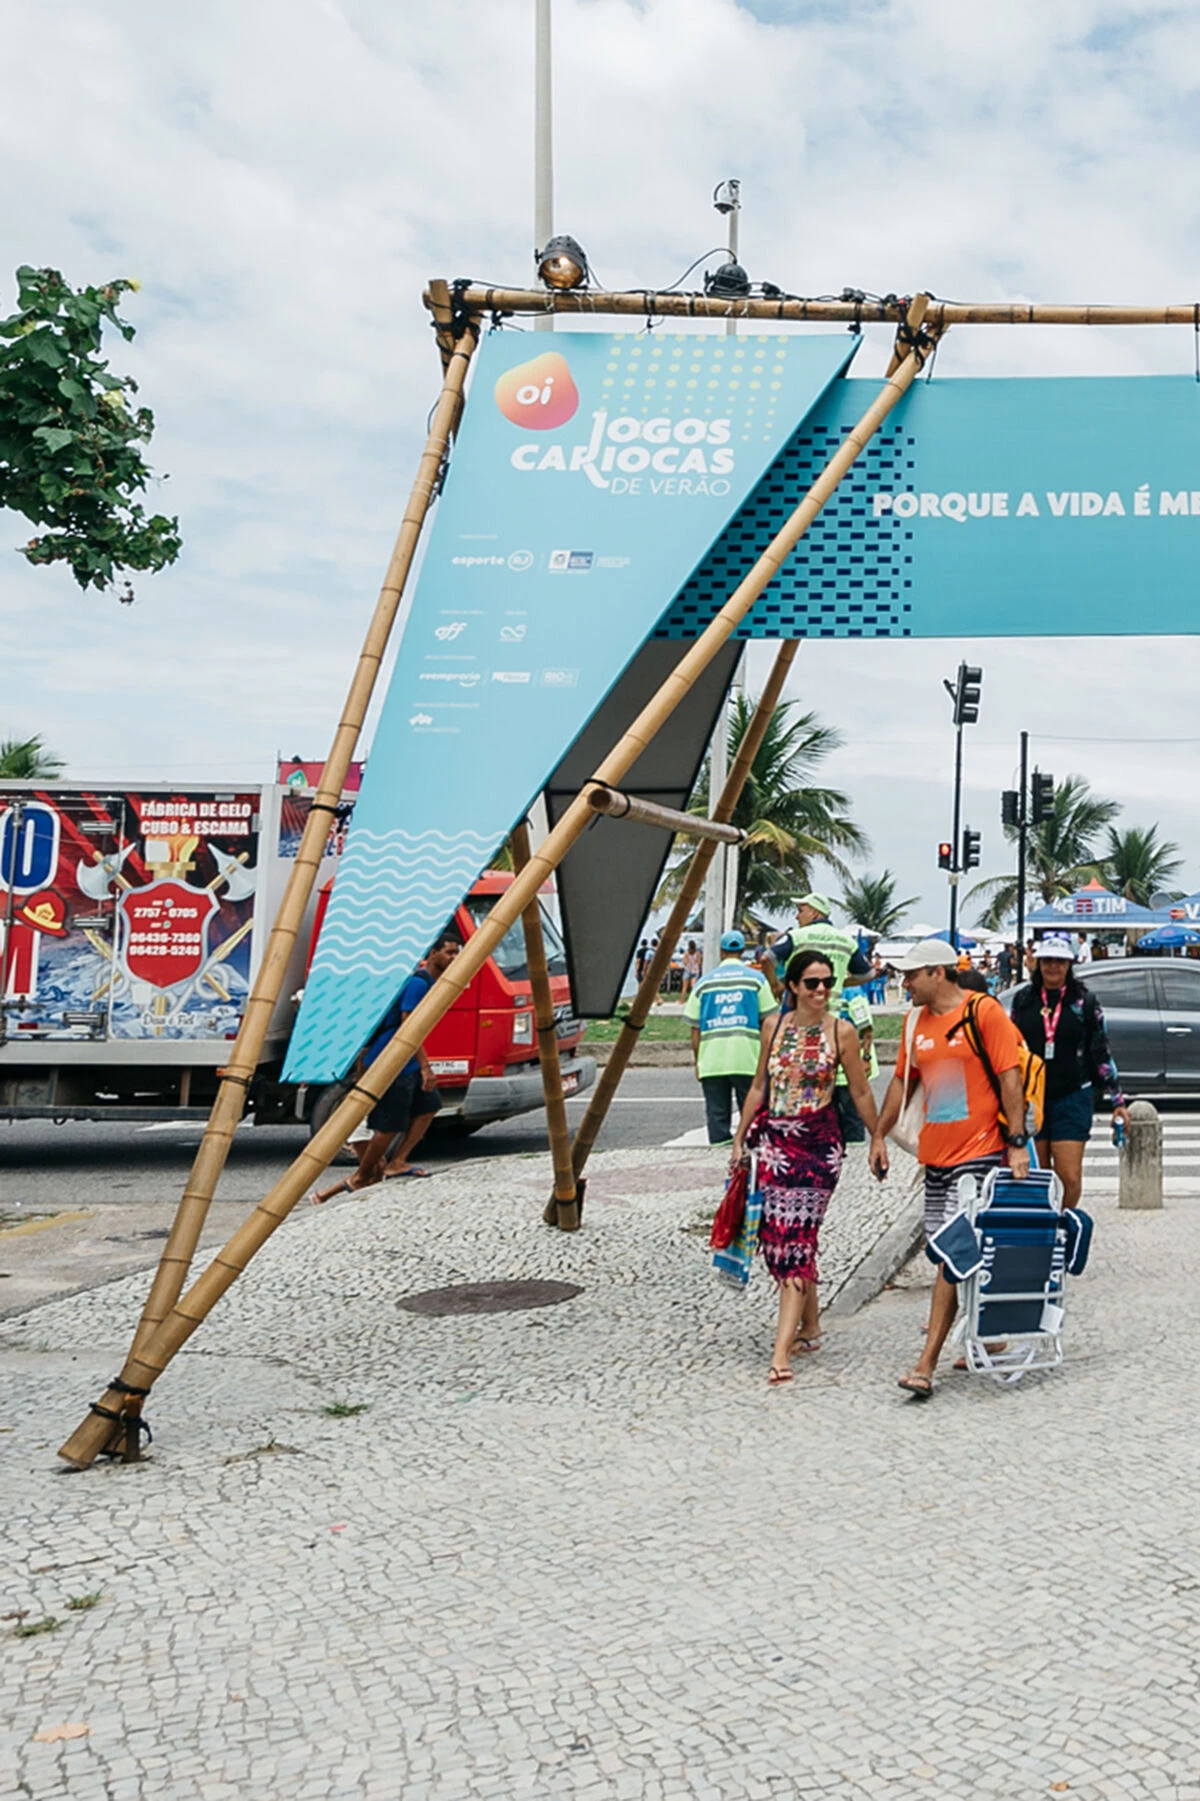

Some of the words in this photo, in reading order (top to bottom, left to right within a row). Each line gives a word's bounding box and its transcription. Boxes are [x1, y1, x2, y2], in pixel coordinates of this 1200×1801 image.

[592, 411, 731, 445] JOGOS
[510, 444, 735, 488] CARIOCAS
[610, 477, 642, 494] DE
[649, 474, 731, 496] VERÃO
[872, 491, 1009, 522] PORQUE
[1016, 491, 1040, 516] A
[1046, 491, 1126, 516] VIDA
[1133, 483, 1151, 516] É
[140, 801, 198, 817] FÁBRICA
[200, 803, 217, 817] DE
[219, 803, 251, 817] GELO
[140, 821, 180, 835] CUBO
[193, 821, 249, 835] ESCAMA
[1094, 897, 1127, 914] TIM
